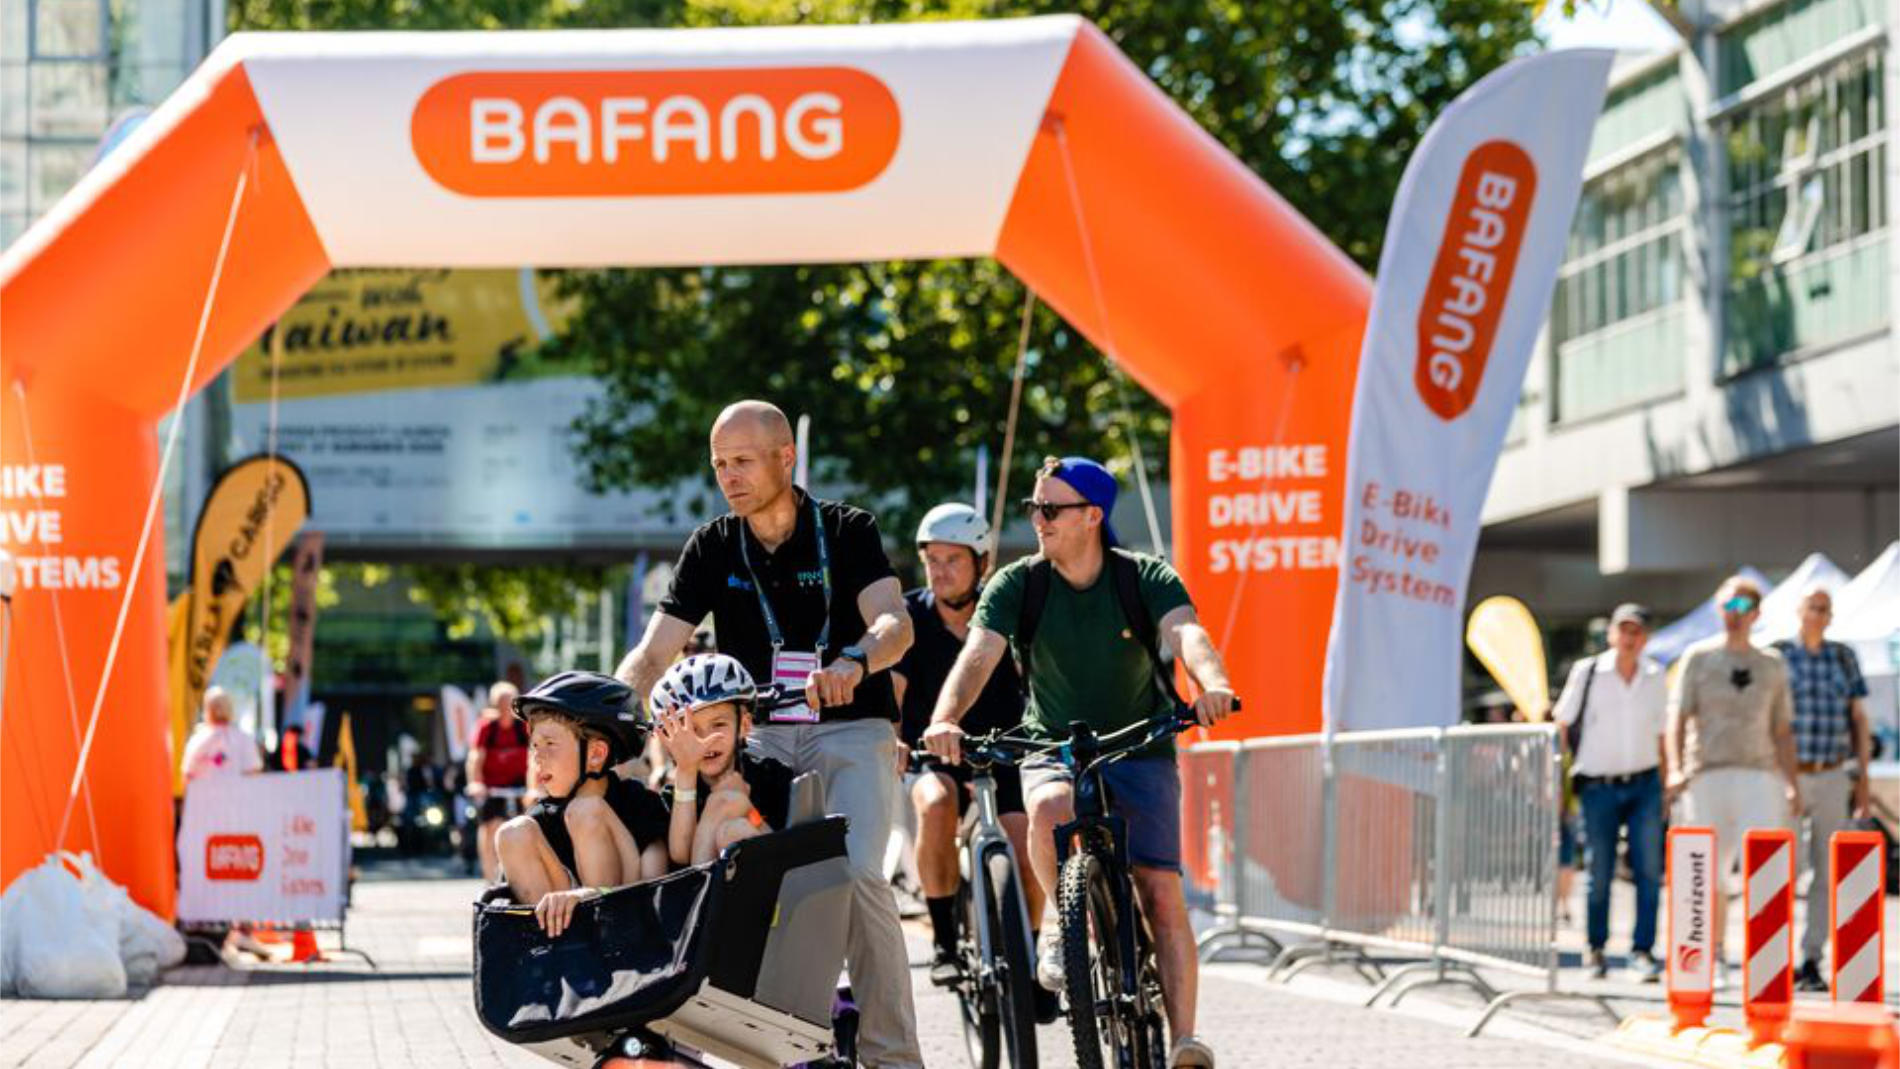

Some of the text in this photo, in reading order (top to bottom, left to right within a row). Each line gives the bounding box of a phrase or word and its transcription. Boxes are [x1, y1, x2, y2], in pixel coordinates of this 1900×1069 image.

[471, 92, 843, 164] BAFANG
[1428, 172, 1518, 391] BAFANG
[261, 306, 457, 355] aiwan
[1207, 445, 1328, 482] E-BIKE
[1208, 491, 1323, 527] DRIVE
[1360, 518, 1440, 565] Drive
[6, 556, 121, 590] TEMS
[1353, 555, 1457, 607] System
[1687, 852, 1705, 942] horizont
